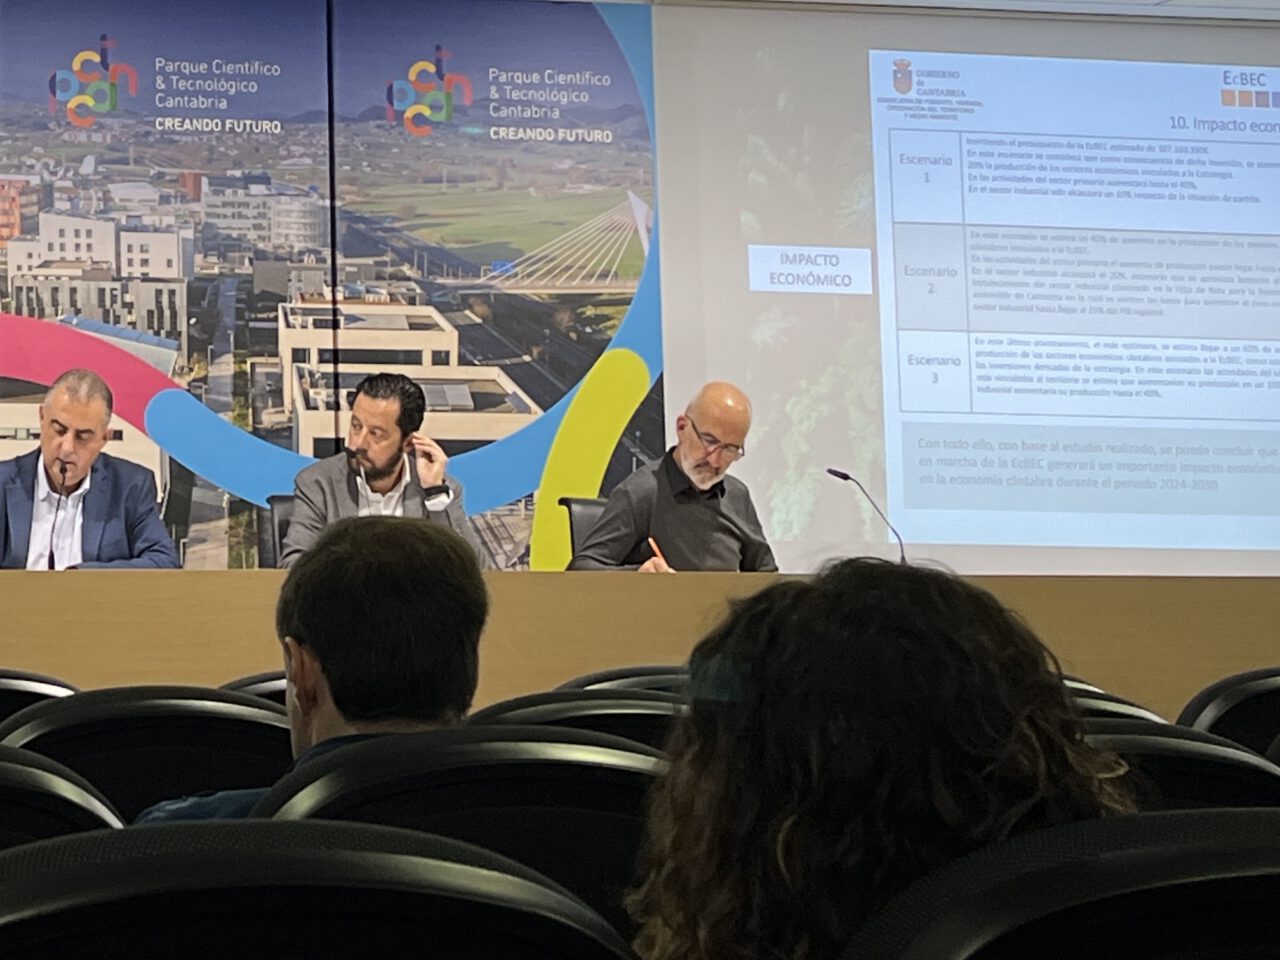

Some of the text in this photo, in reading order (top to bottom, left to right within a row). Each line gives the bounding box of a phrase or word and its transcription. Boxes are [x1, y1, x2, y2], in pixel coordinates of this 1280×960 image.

[155, 58, 280, 76] Parque Científico
[489, 68, 611, 86] Parque Científico
[1223, 70, 1267, 86] EcBEC
[156, 76, 258, 94] & Tecnológico
[156, 93, 228, 109] Cantabria
[489, 86, 589, 104] & Tecnológico
[489, 104, 560, 119] Cantabria
[156, 118, 281, 133] CREANDO FUTURO
[1170, 117, 1189, 129] 10.
[1194, 117, 1246, 133] Impacto
[490, 127, 612, 143] CREANDO FUTURO
[899, 153, 952, 166] Escenario
[923, 172, 930, 183] 1
[780, 253, 840, 267] IMPACTO
[904, 265, 958, 277] Escenario
[770, 271, 852, 287] ECONÓMICO
[928, 283, 935, 294] 2
[908, 354, 961, 366] Escenario
[932, 372, 938, 384] 3
[918, 438, 940, 448] Con
[944, 439, 968, 449] todo
[998, 442, 1018, 451] con
[1022, 441, 1047, 451] base
[1062, 442, 1102, 452] estudio
[1160, 446, 1171, 455] se
[1258, 448, 1278, 458] que
[919, 458, 932, 466] en
[936, 457, 978, 468] marcha
[981, 458, 994, 468] de
[998, 458, 1008, 468] la
[1048, 458, 1095, 472] generará
[919, 476, 934, 484] en
[936, 473, 946, 484] la
[949, 475, 1003, 485] economía
[1006, 476, 1053, 487] cántabra
[1056, 477, 1099, 488] durante
[1102, 478, 1111, 488] el
